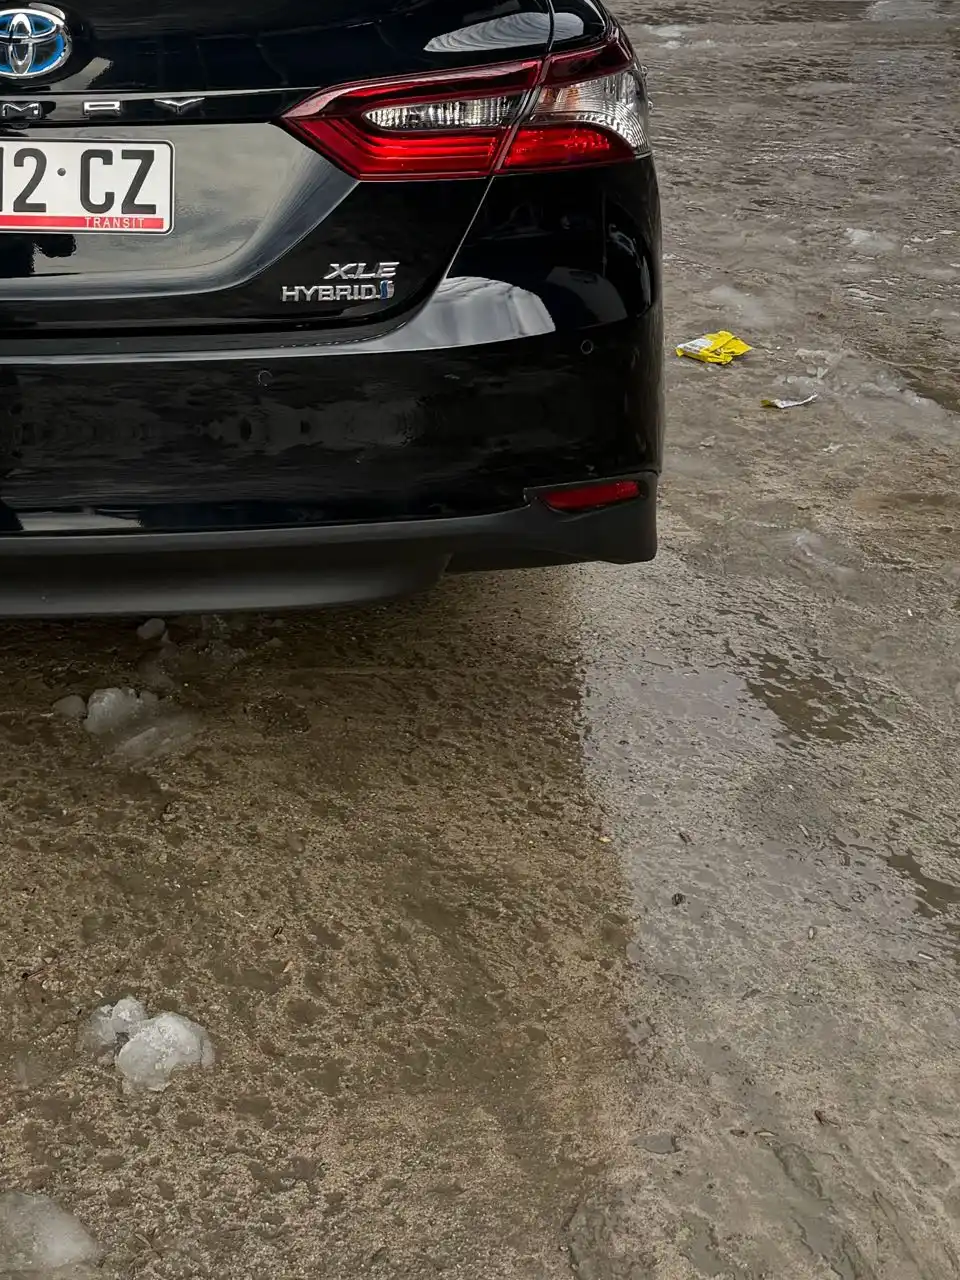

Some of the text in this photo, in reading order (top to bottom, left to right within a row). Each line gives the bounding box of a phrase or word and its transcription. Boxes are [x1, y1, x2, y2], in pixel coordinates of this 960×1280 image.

[80, 149, 157, 215] CZ
[84, 216, 145, 229] TRANSIT
[323, 261, 400, 279] XLE
[281, 284, 380, 302] HYBRID
